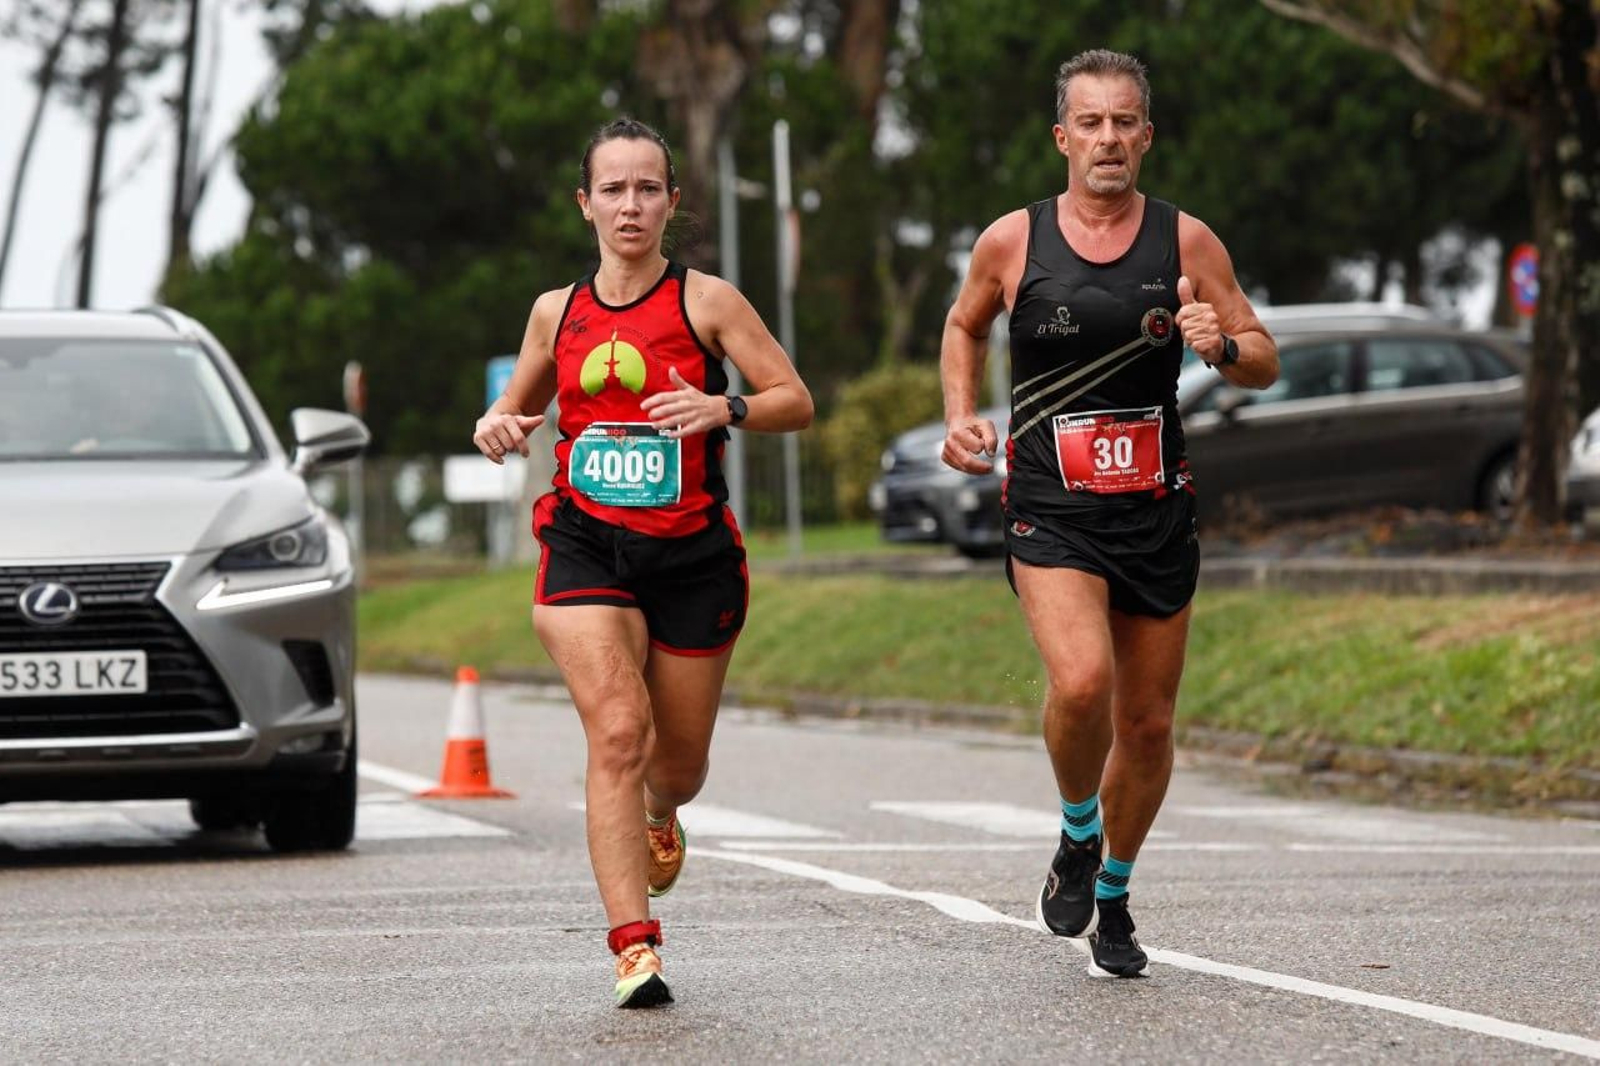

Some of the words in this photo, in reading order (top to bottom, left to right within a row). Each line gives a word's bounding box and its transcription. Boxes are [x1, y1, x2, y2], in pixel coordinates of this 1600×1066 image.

[1037, 324, 1046, 335] El
[1047, 324, 1080, 337] Trigal
[583, 449, 665, 483] 4009
[1093, 436, 1133, 470] 30
[1, 661, 62, 690] 533
[75, 659, 137, 689] LKZ
